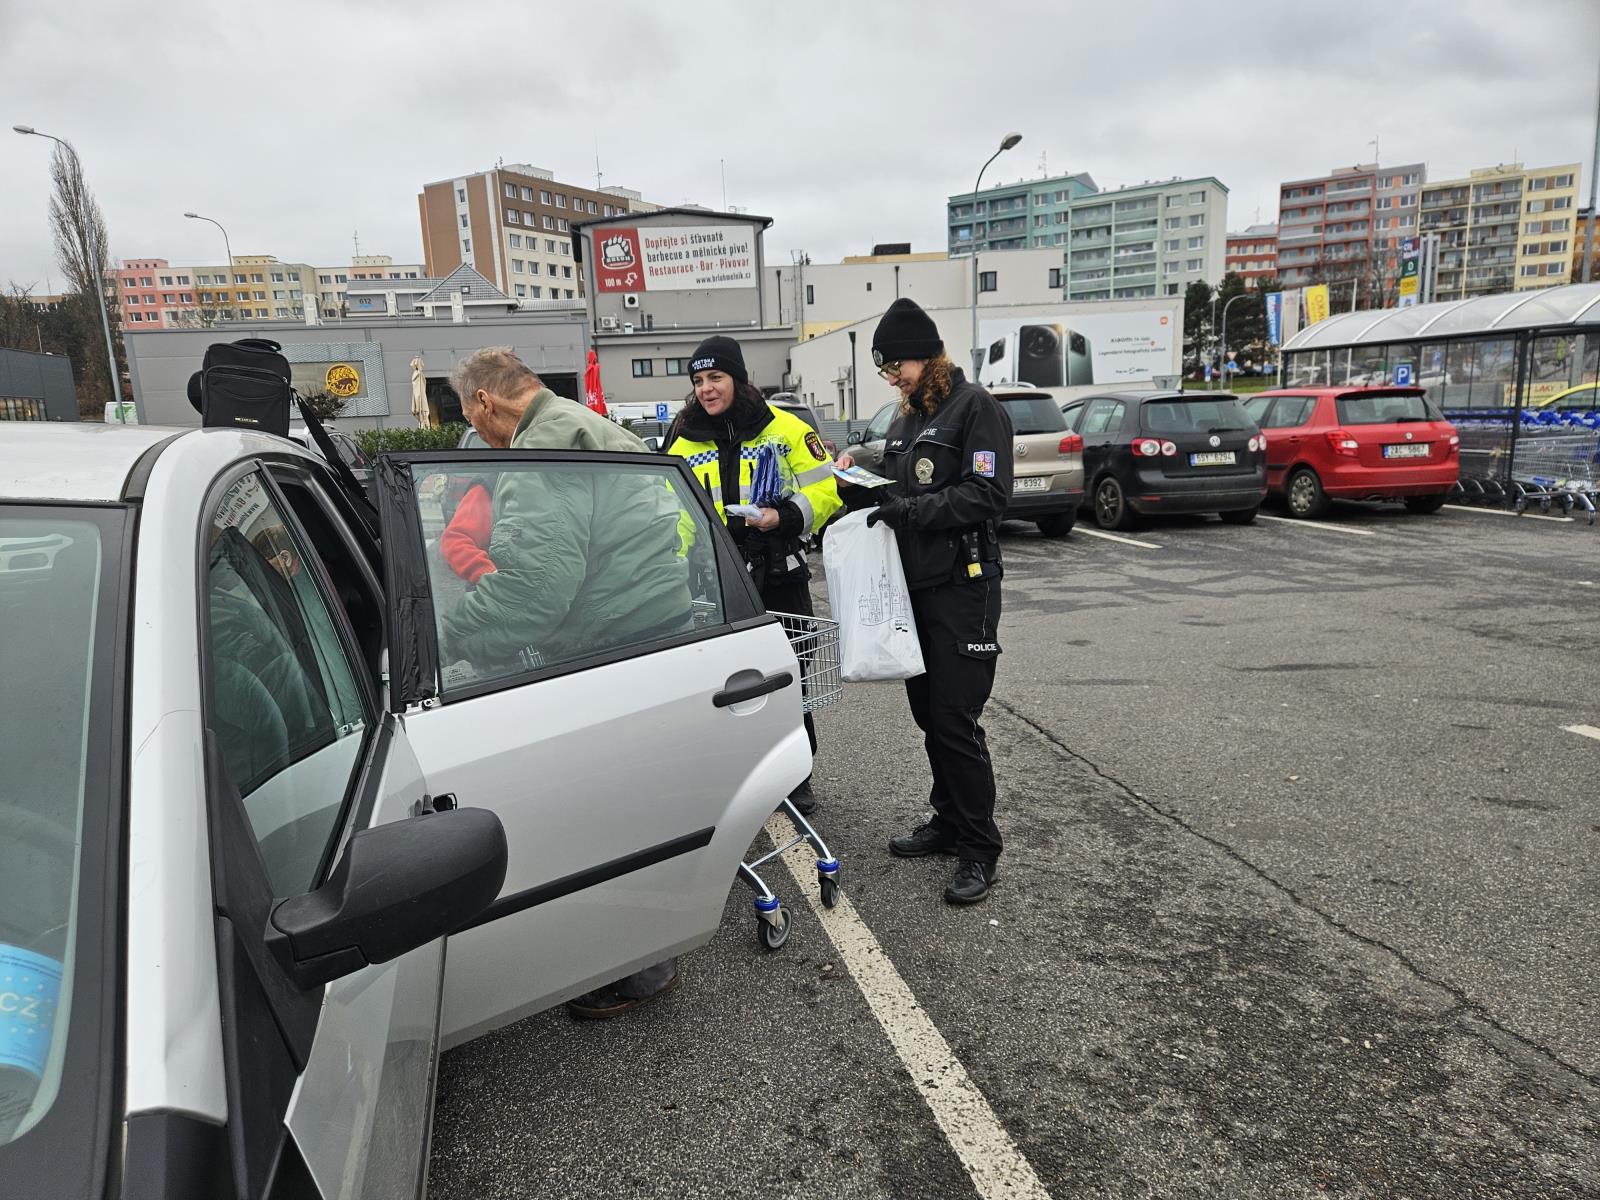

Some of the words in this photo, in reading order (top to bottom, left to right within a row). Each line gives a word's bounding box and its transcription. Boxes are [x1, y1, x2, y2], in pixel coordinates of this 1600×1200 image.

[645, 236, 678, 249] Dopřejte
[681, 235, 688, 245] si
[647, 250, 682, 263] barbecue
[685, 250, 690, 259] a
[692, 244, 727, 258] mělnické
[729, 242, 748, 256] pivo!
[649, 264, 694, 277] Restaurace
[700, 260, 713, 271] Bar
[720, 257, 749, 269] Pivovar
[605, 278, 615, 287] 100
[1397, 367, 1408, 383] P
[658, 405, 666, 416] P
[0, 992, 42, 1019] CZ
